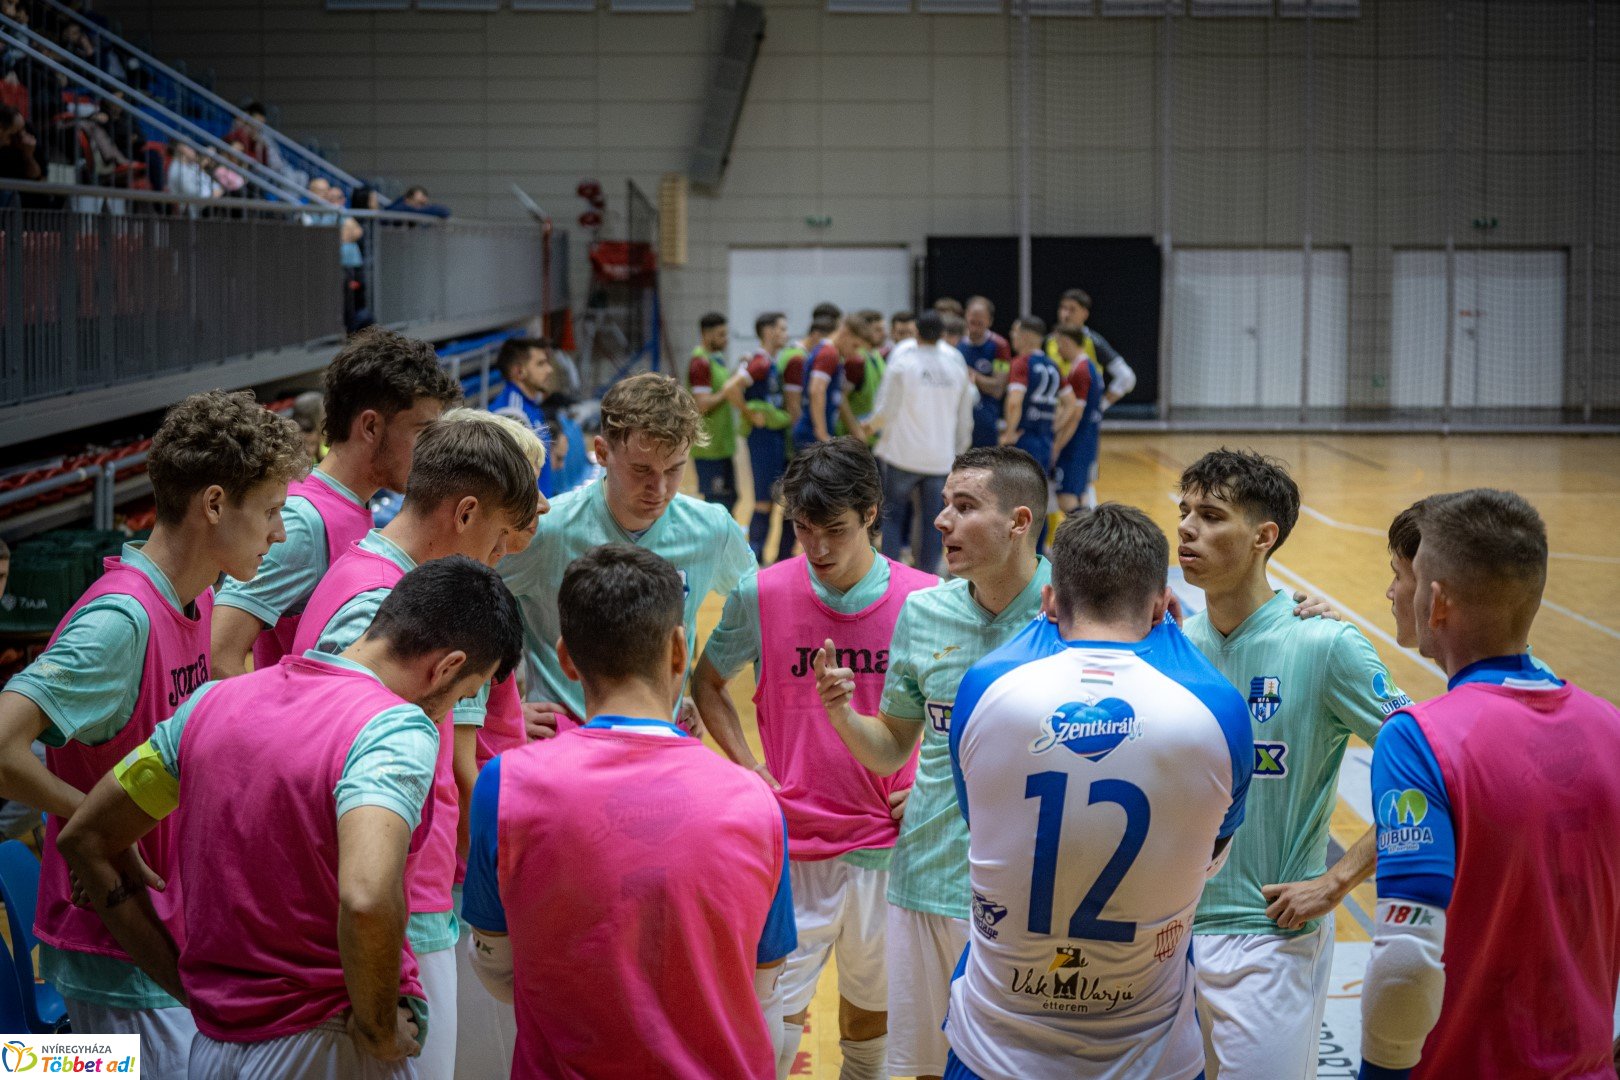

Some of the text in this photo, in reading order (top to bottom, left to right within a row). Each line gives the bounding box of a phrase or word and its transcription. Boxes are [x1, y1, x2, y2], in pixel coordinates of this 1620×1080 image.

[1031, 362, 1061, 405] 22
[168, 653, 209, 707] Joma
[1027, 711, 1145, 756] Szentkirályi
[1024, 770, 1151, 943] 12
[1011, 967, 1051, 999] Vak
[1042, 999, 1089, 1013] étterem
